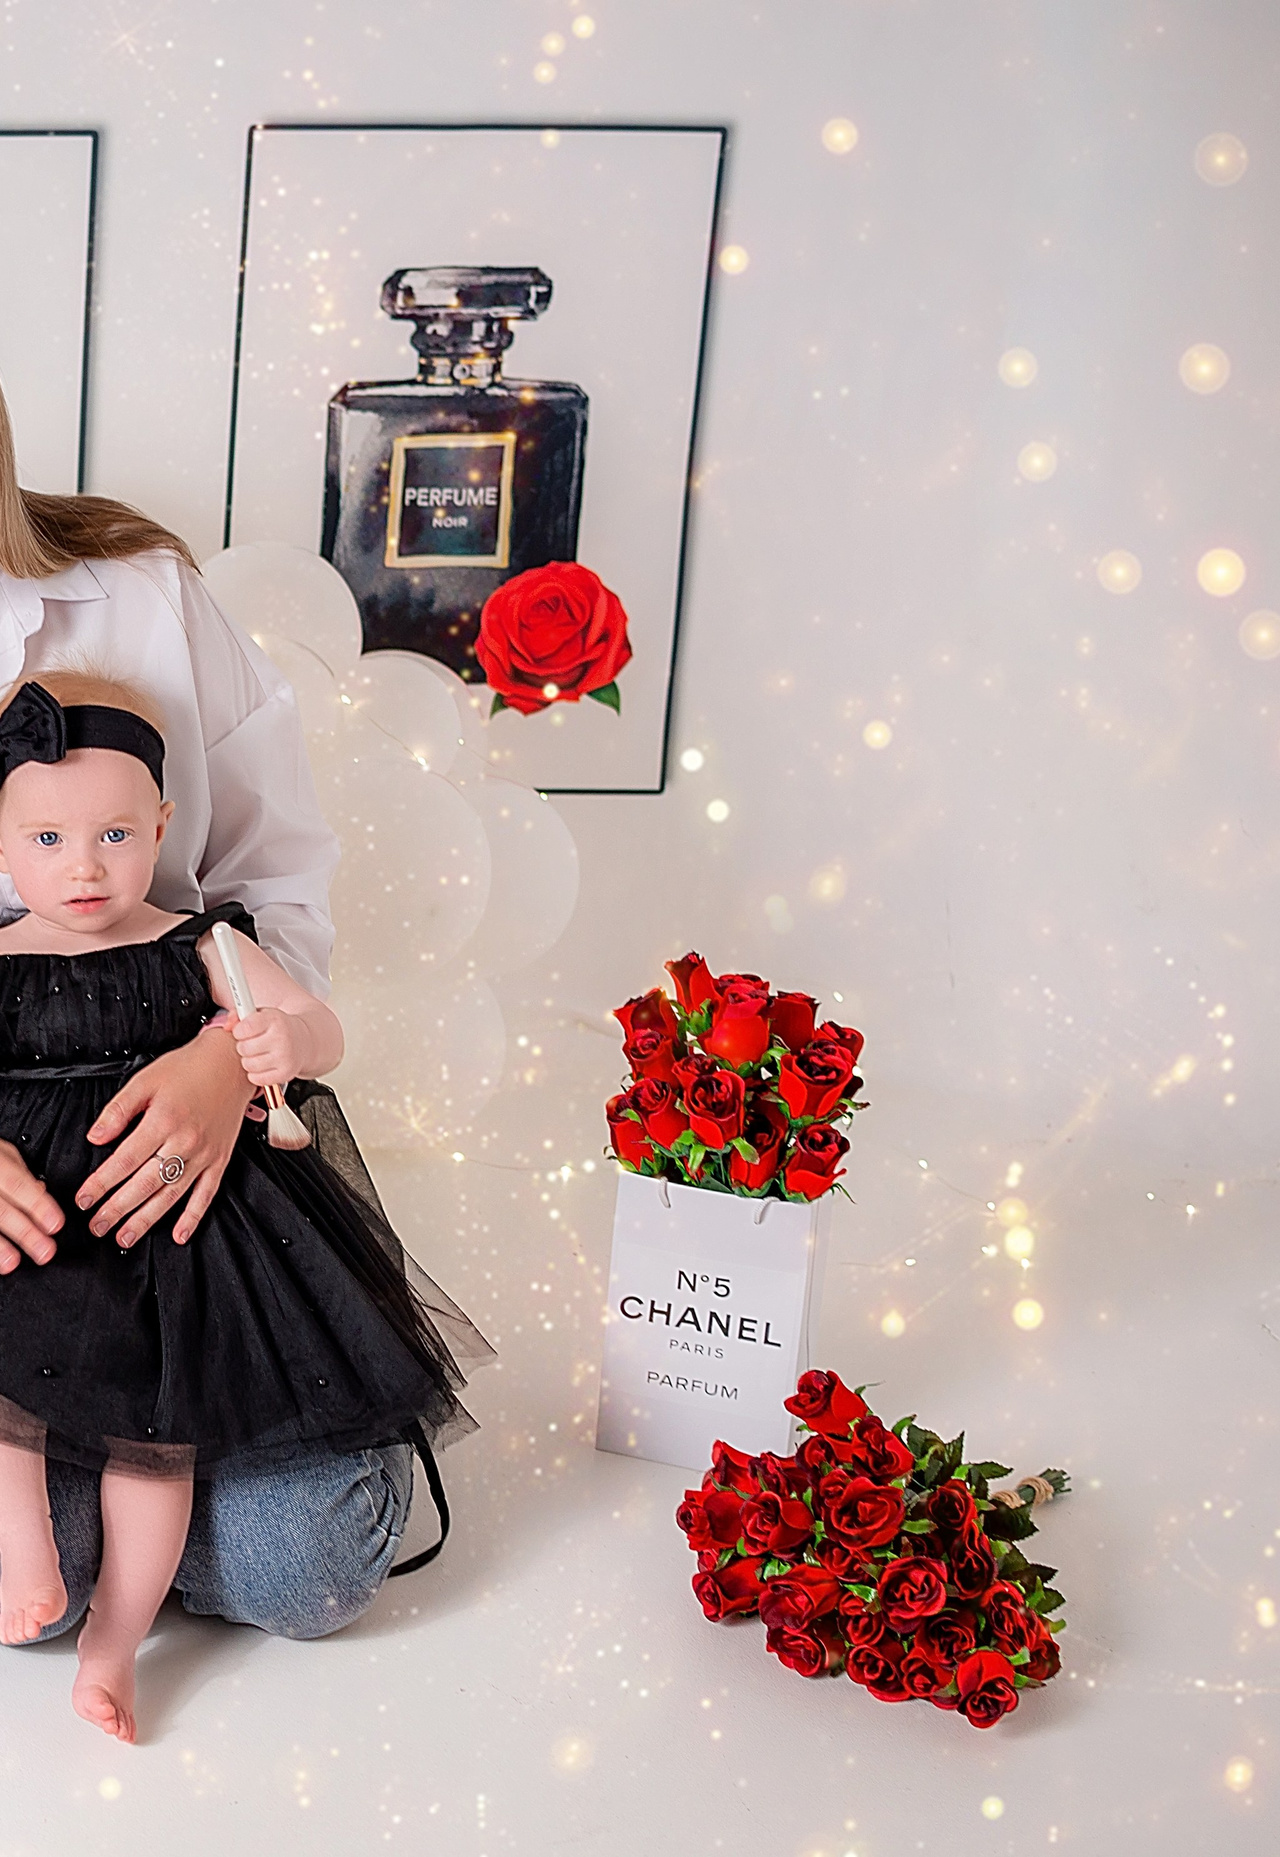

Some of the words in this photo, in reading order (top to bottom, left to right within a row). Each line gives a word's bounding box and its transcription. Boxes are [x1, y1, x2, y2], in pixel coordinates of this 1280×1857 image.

[404, 486, 498, 507] PERFUME
[432, 516, 468, 528] NOIR
[620, 1296, 782, 1348] CHANEL
[669, 1339, 724, 1359] PARIS
[647, 1371, 739, 1400] PARFUM
